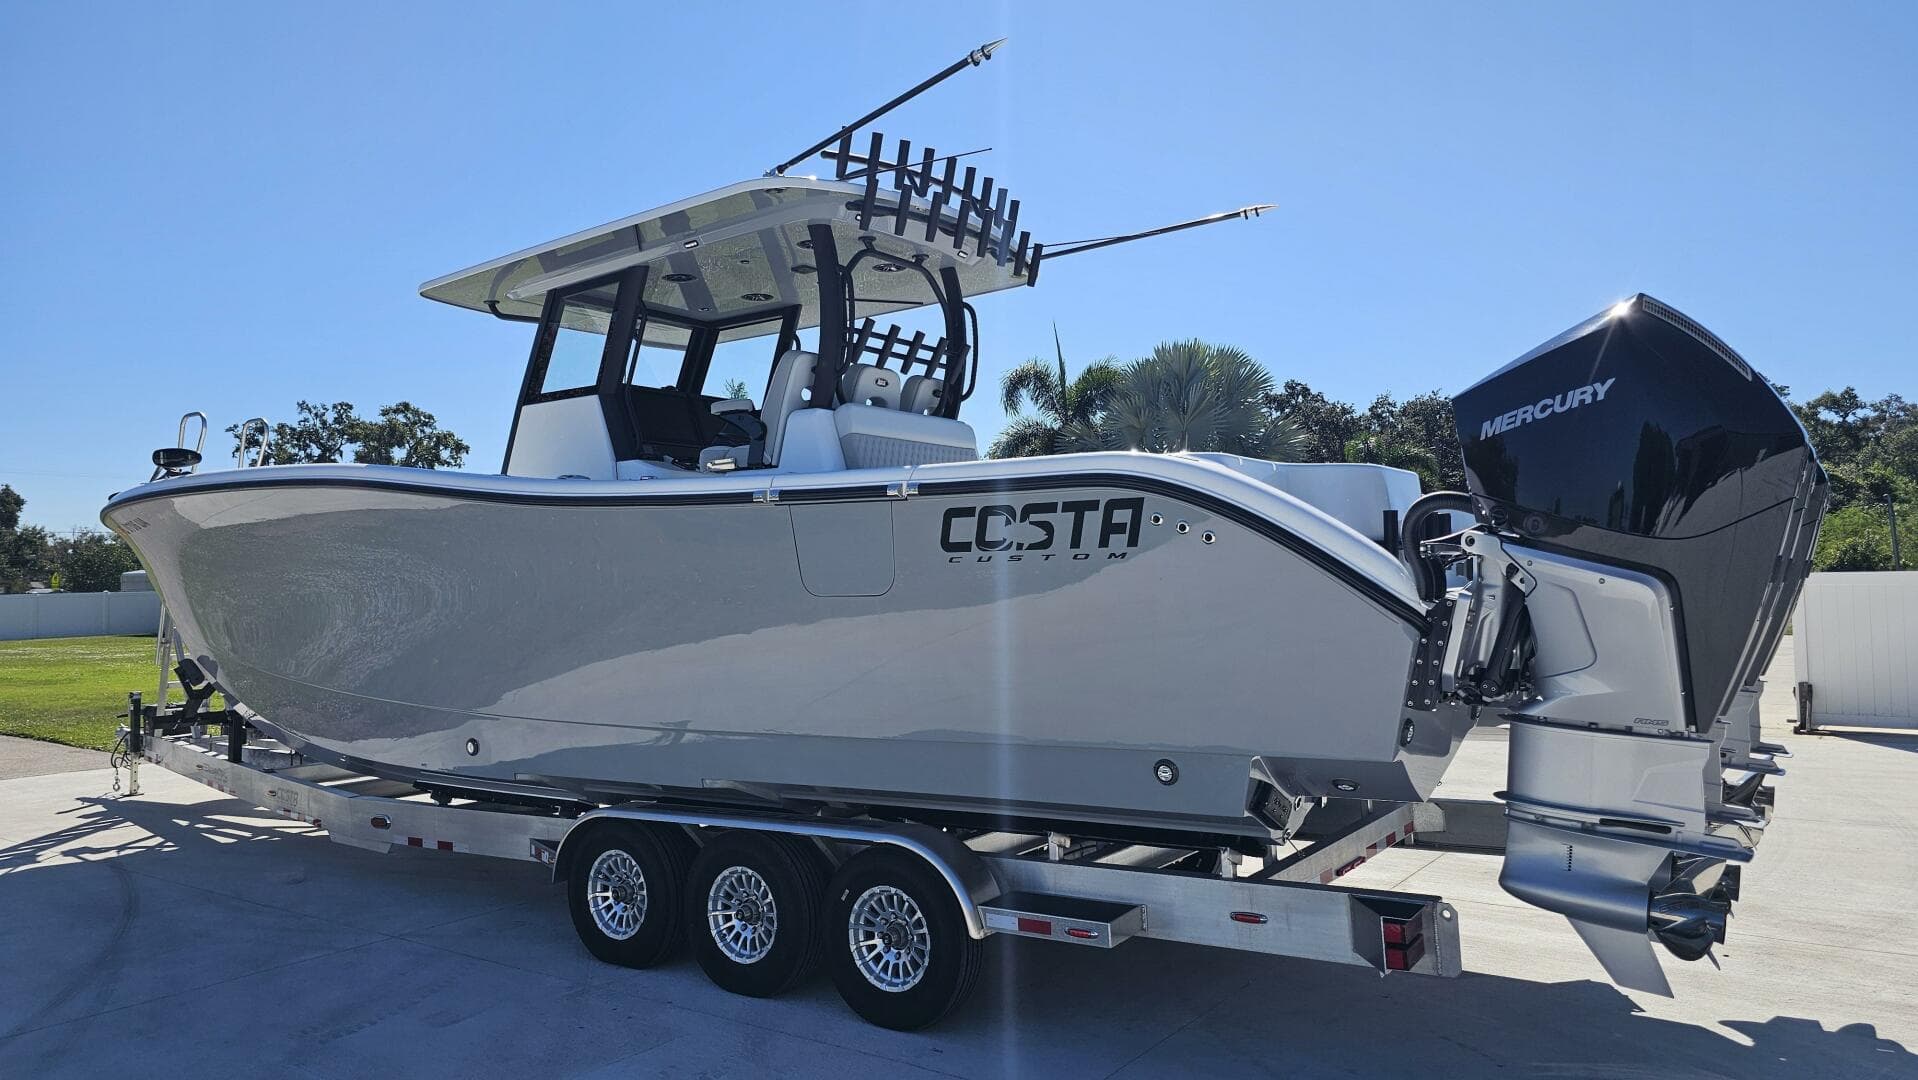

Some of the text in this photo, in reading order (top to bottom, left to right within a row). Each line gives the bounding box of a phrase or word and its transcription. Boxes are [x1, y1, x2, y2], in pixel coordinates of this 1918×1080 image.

[1479, 377, 1616, 441] MERCURY
[940, 497, 1145, 552] COSTA
[948, 552, 1128, 563] CUSTOM
